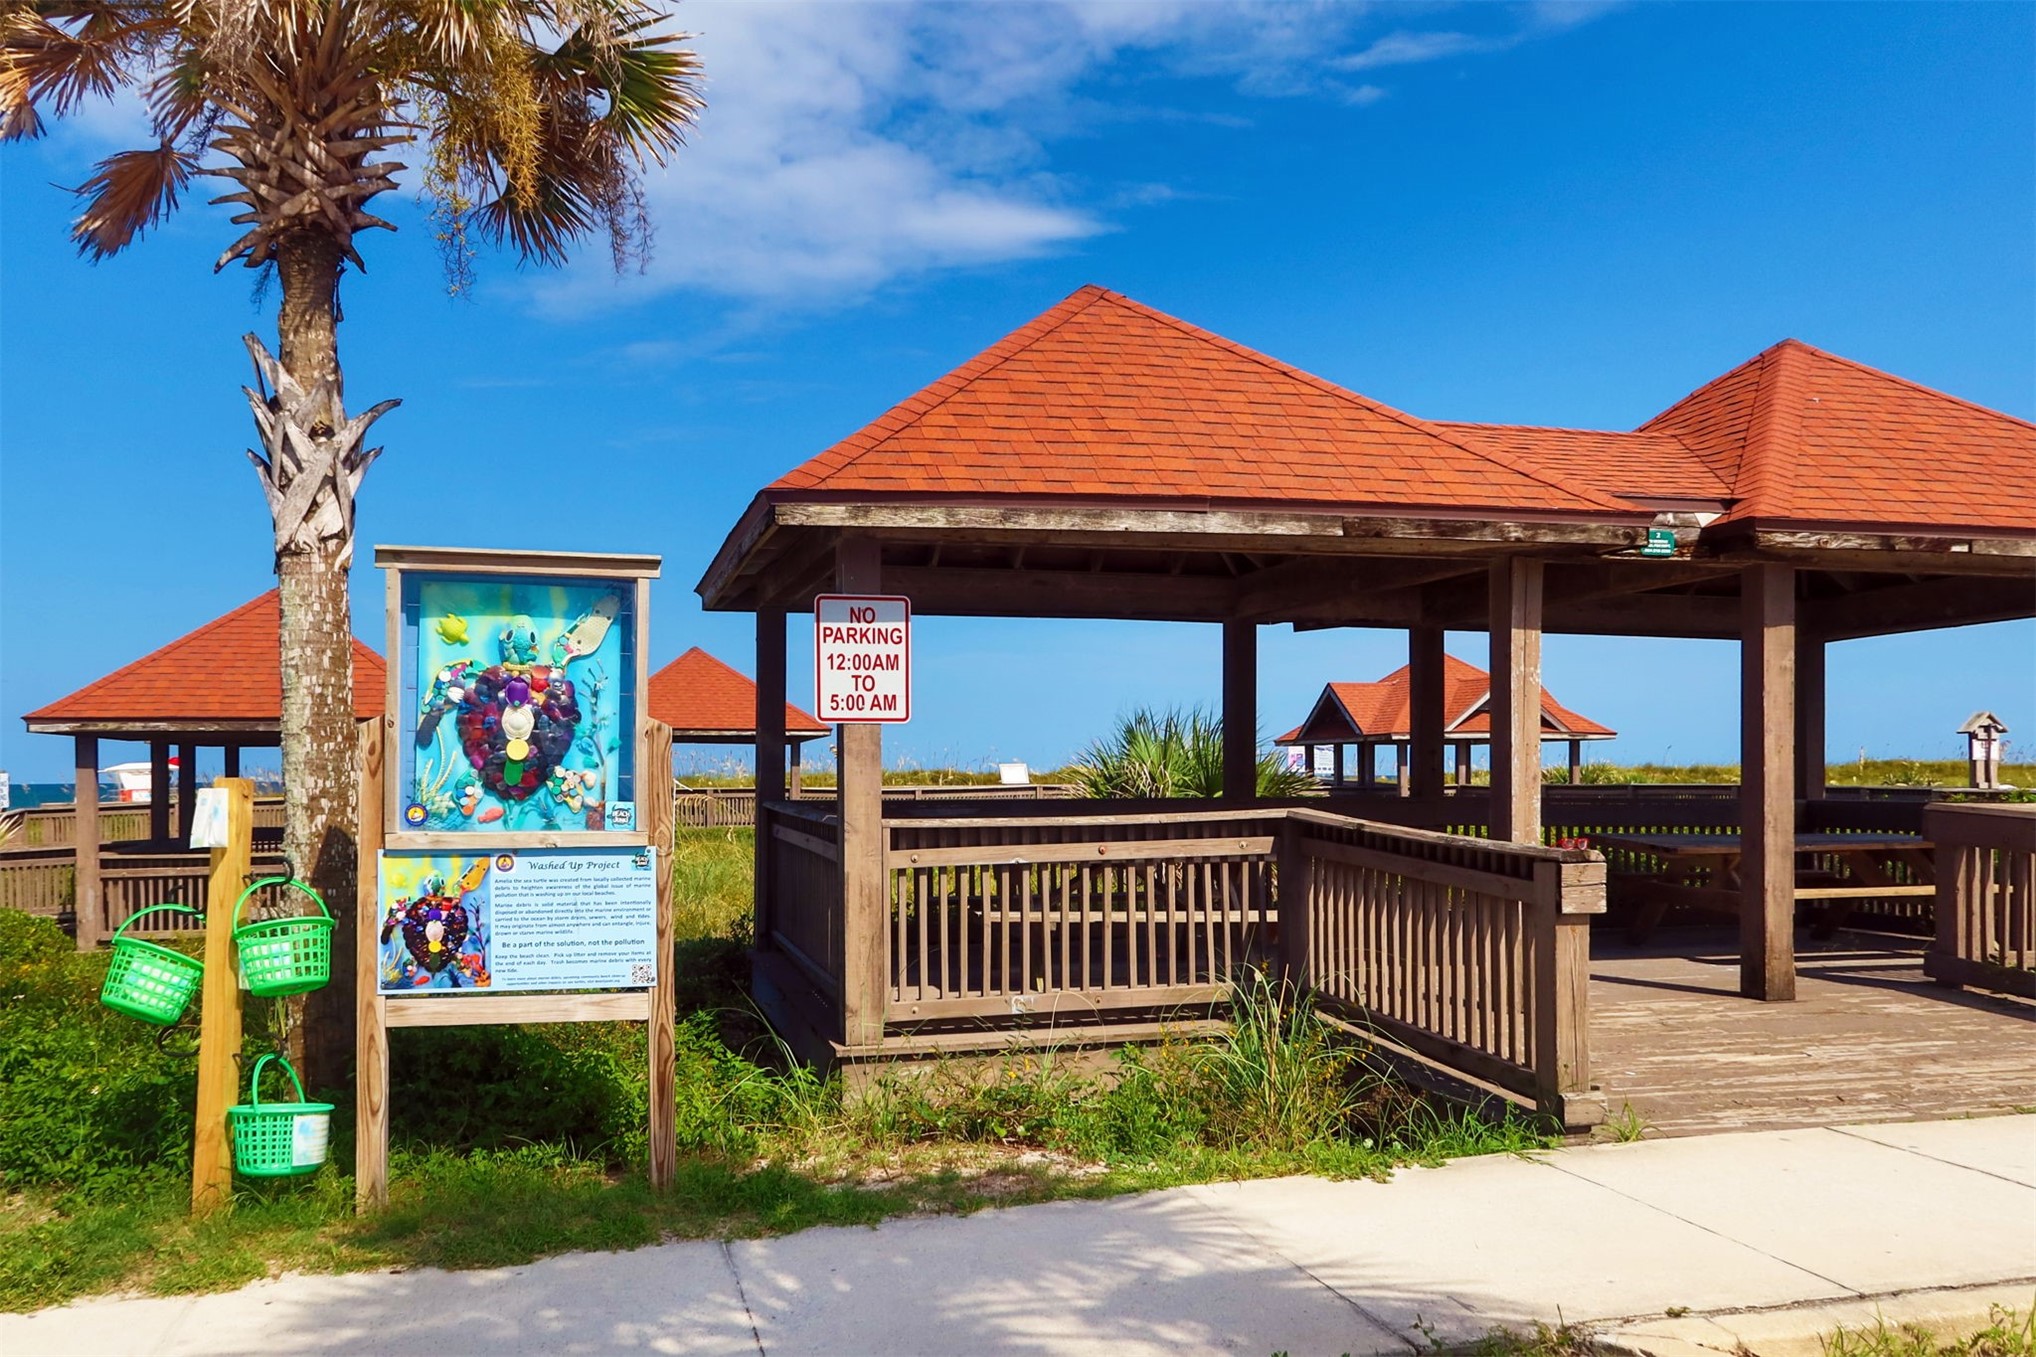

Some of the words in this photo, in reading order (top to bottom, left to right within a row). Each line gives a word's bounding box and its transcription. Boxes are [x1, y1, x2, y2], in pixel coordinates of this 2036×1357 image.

[850, 607, 875, 624] NO
[823, 627, 903, 644] PARKING
[827, 654, 899, 671] 12:00AM
[852, 675, 875, 692] TO
[830, 694, 865, 711] 5:00
[870, 694, 897, 711] AM
[528, 861, 567, 870] Washed
[568, 861, 583, 872] Up
[586, 861, 620, 873] Project
